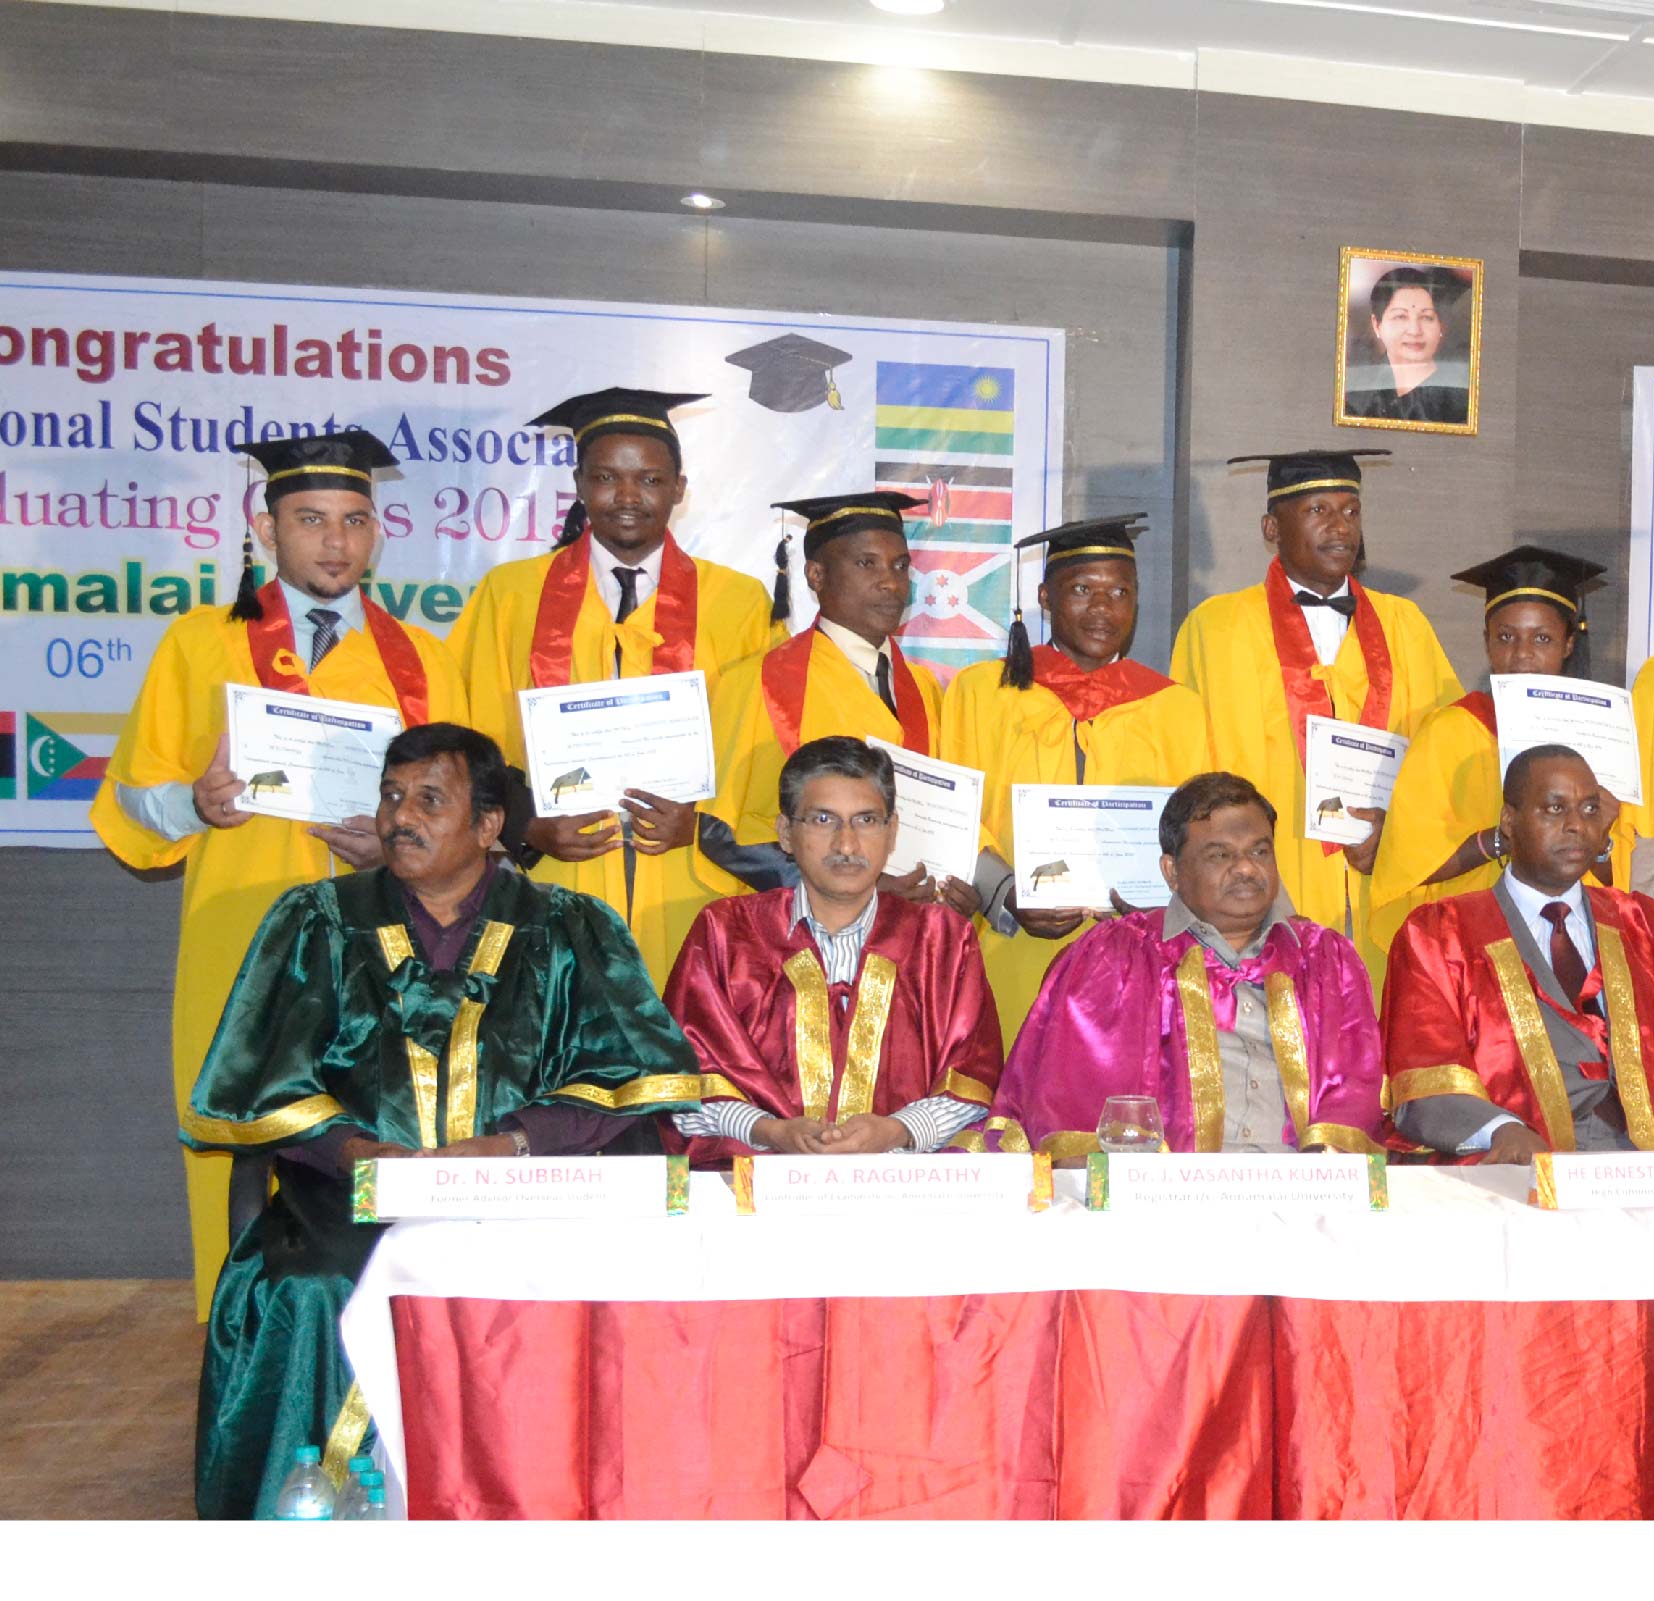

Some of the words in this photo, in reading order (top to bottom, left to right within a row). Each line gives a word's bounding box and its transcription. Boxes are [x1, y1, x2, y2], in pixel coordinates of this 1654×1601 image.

[47, 637, 132, 678] 06th
[436, 1169, 466, 1185] Dr.
[476, 1169, 497, 1185] N.
[505, 1168, 602, 1184] SUBBIAH
[788, 1169, 816, 1184] Dr.
[825, 1169, 844, 1183] A.
[853, 1168, 981, 1183] RAGUPATHY
[1128, 1168, 1154, 1182] Dr.
[1161, 1168, 1173, 1182] J.
[1179, 1168, 1282, 1182] VASANTHA
[1289, 1167, 1359, 1181] KUMAR
[1568, 1168, 1587, 1180] HE
[1595, 1166, 1654, 1179] ERNEST
